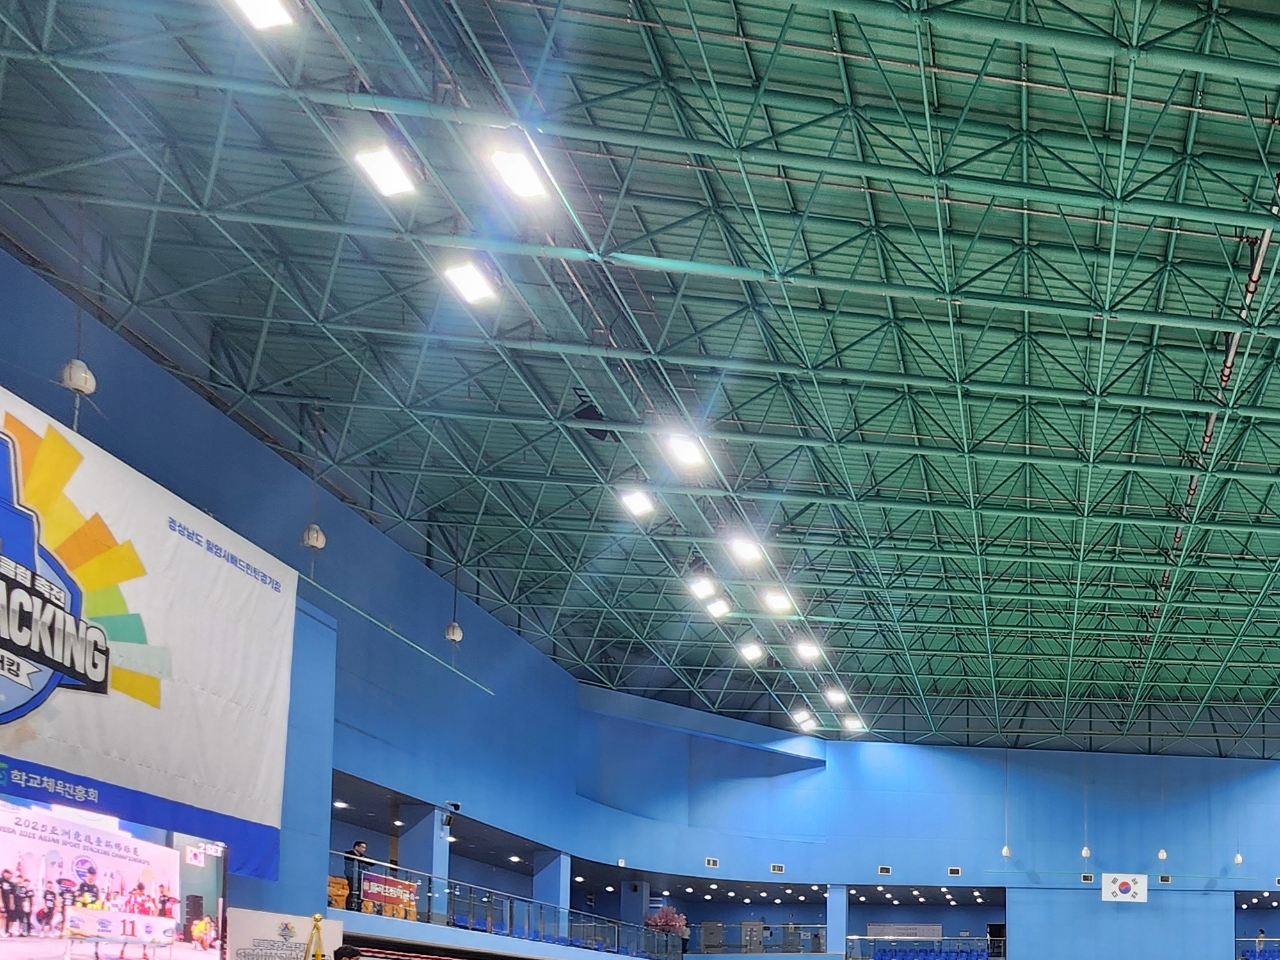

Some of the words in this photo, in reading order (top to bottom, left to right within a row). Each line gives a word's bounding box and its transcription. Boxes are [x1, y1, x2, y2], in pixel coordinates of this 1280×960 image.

[168, 516, 204, 547] 경상남도
[10, 769, 99, 803] 학교체육진흥회
[120, 919, 137, 937] 11
